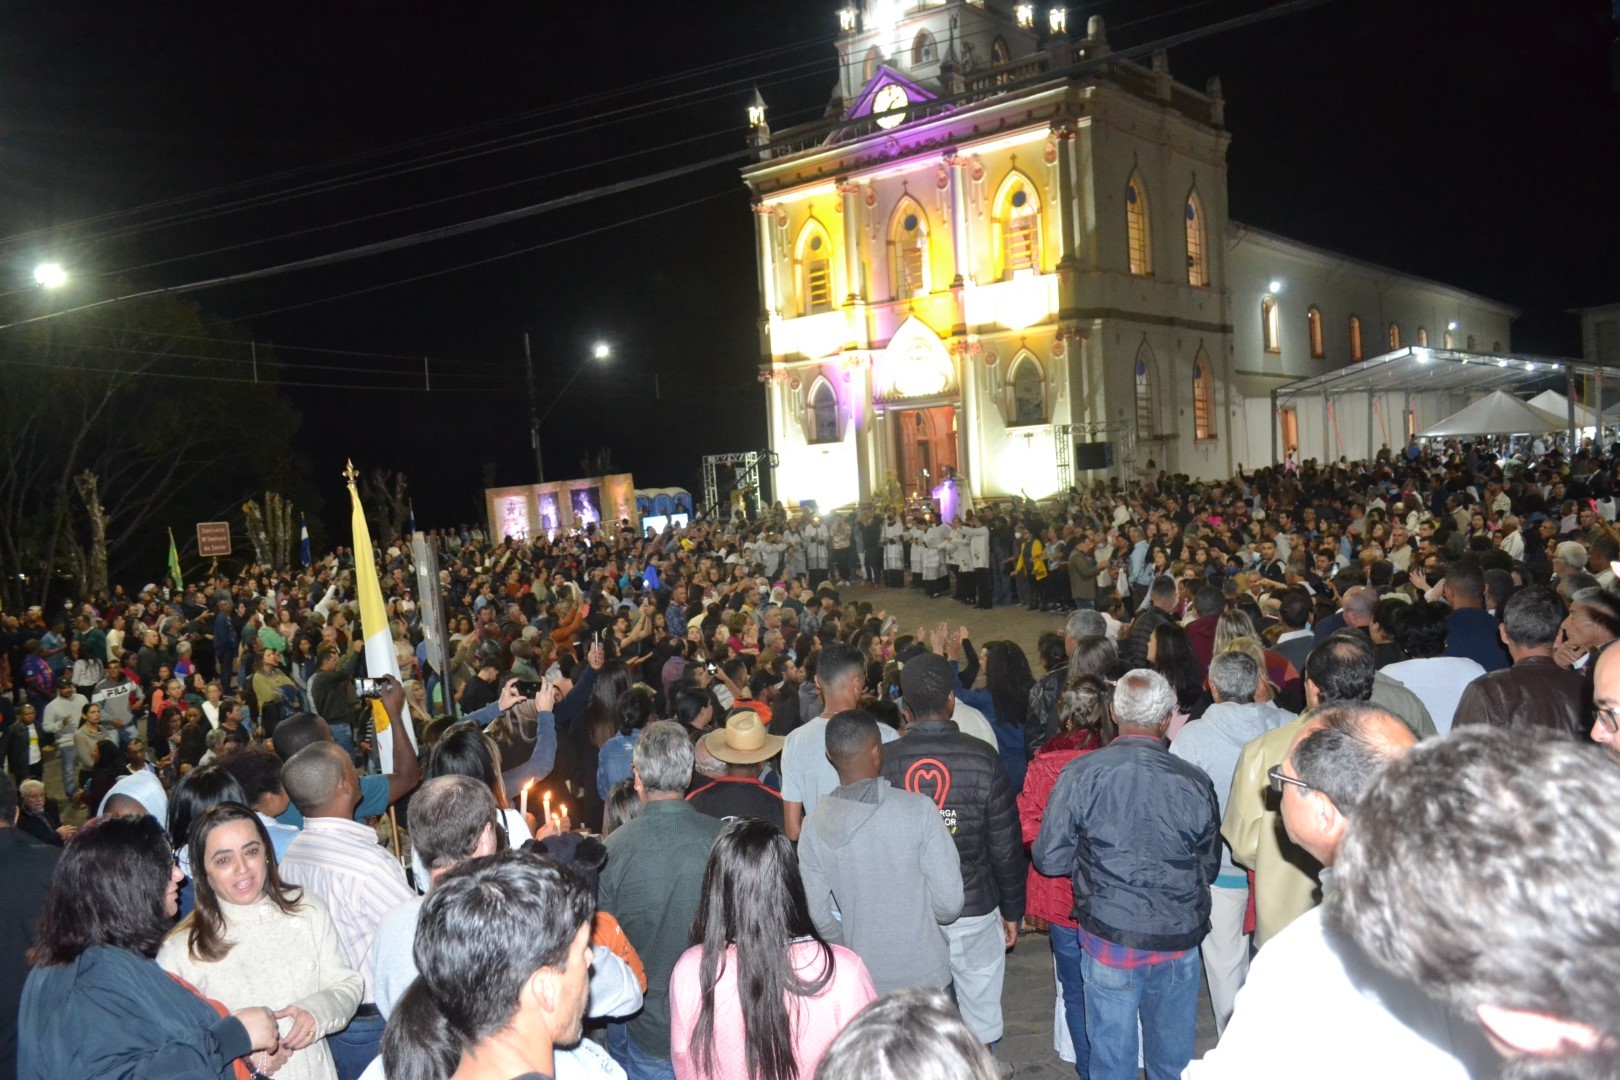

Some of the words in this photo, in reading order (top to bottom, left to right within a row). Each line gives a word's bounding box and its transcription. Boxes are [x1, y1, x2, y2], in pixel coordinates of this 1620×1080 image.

[106, 686, 128, 697] FILA
[940, 809, 957, 817] RGA
[944, 818, 957, 826] OR
